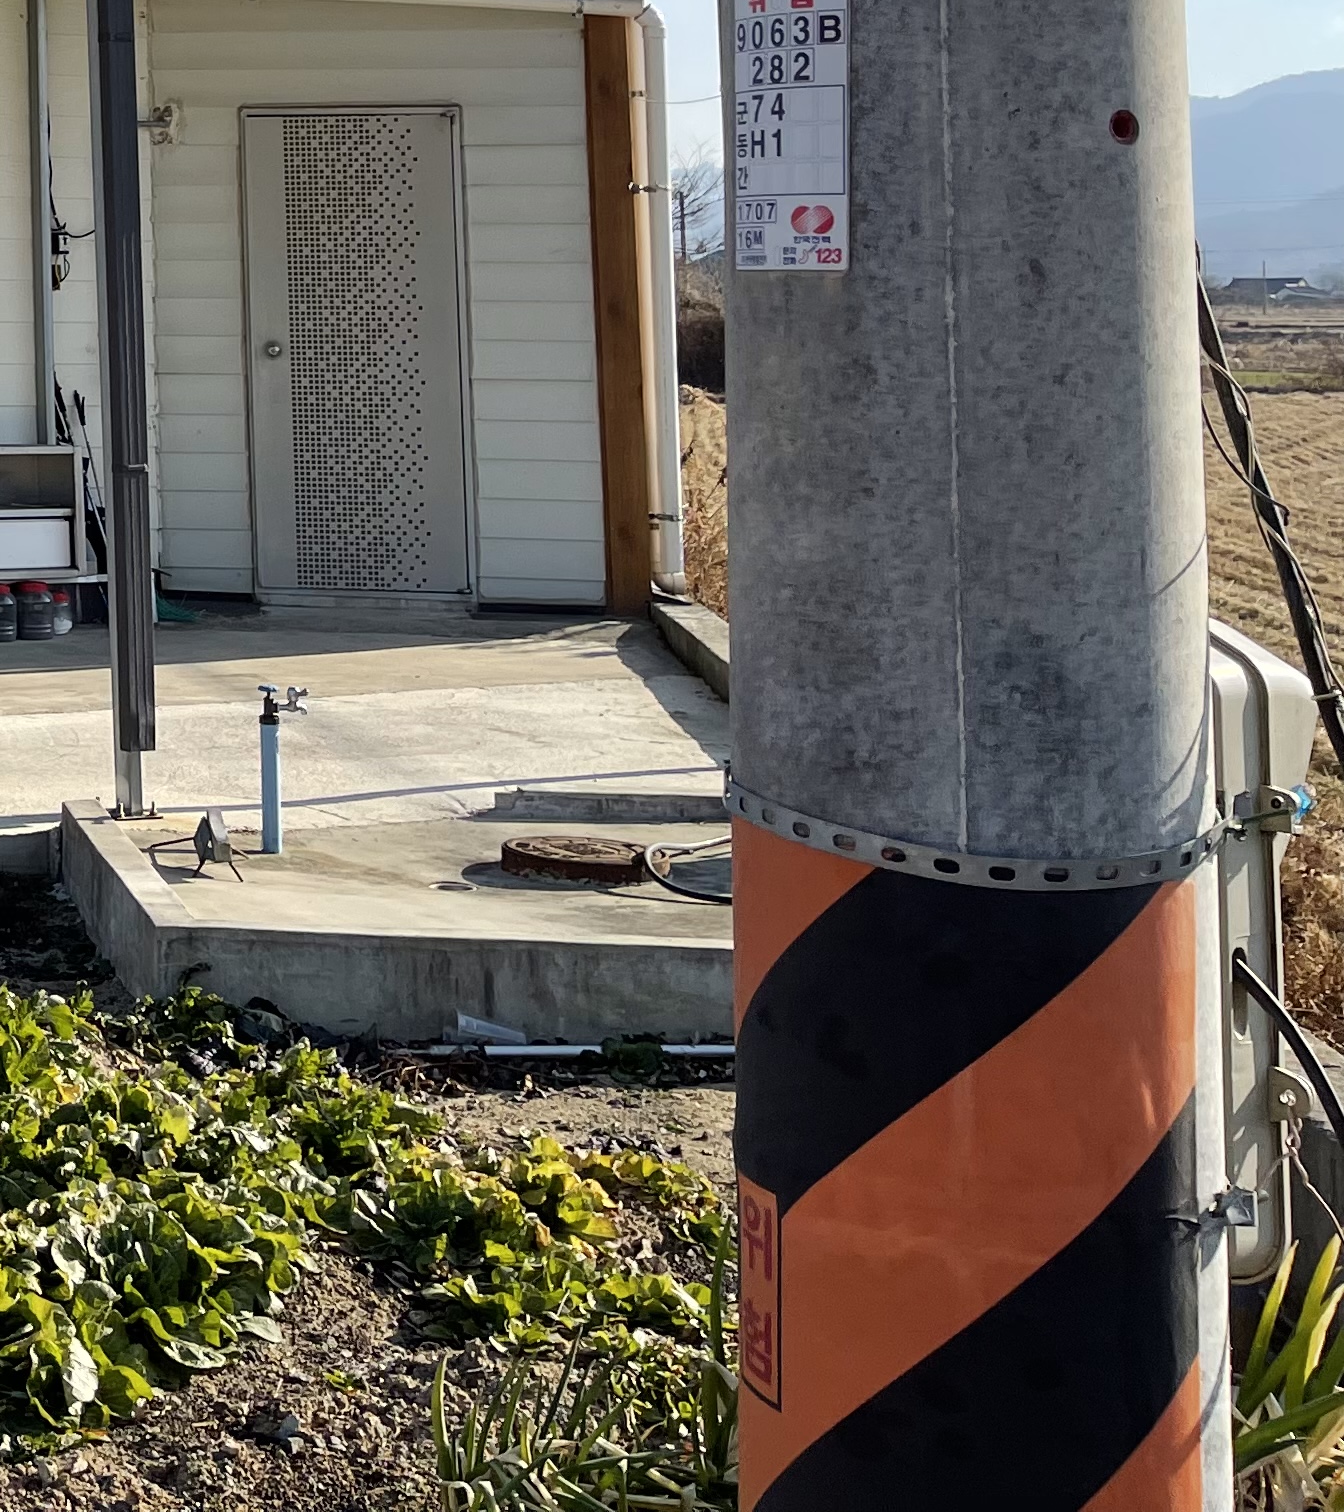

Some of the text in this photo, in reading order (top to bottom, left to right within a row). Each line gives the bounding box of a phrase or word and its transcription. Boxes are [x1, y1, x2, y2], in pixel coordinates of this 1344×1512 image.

[737, 14, 842, 51] 9063B
[752, 51, 811, 85] 282
[751, 93, 786, 124] 74
[750, 128, 783, 159] H1
[738, 202, 776, 221] 1707
[815, 247, 842, 264] 123
[743, 1194, 773, 1385] 위험
